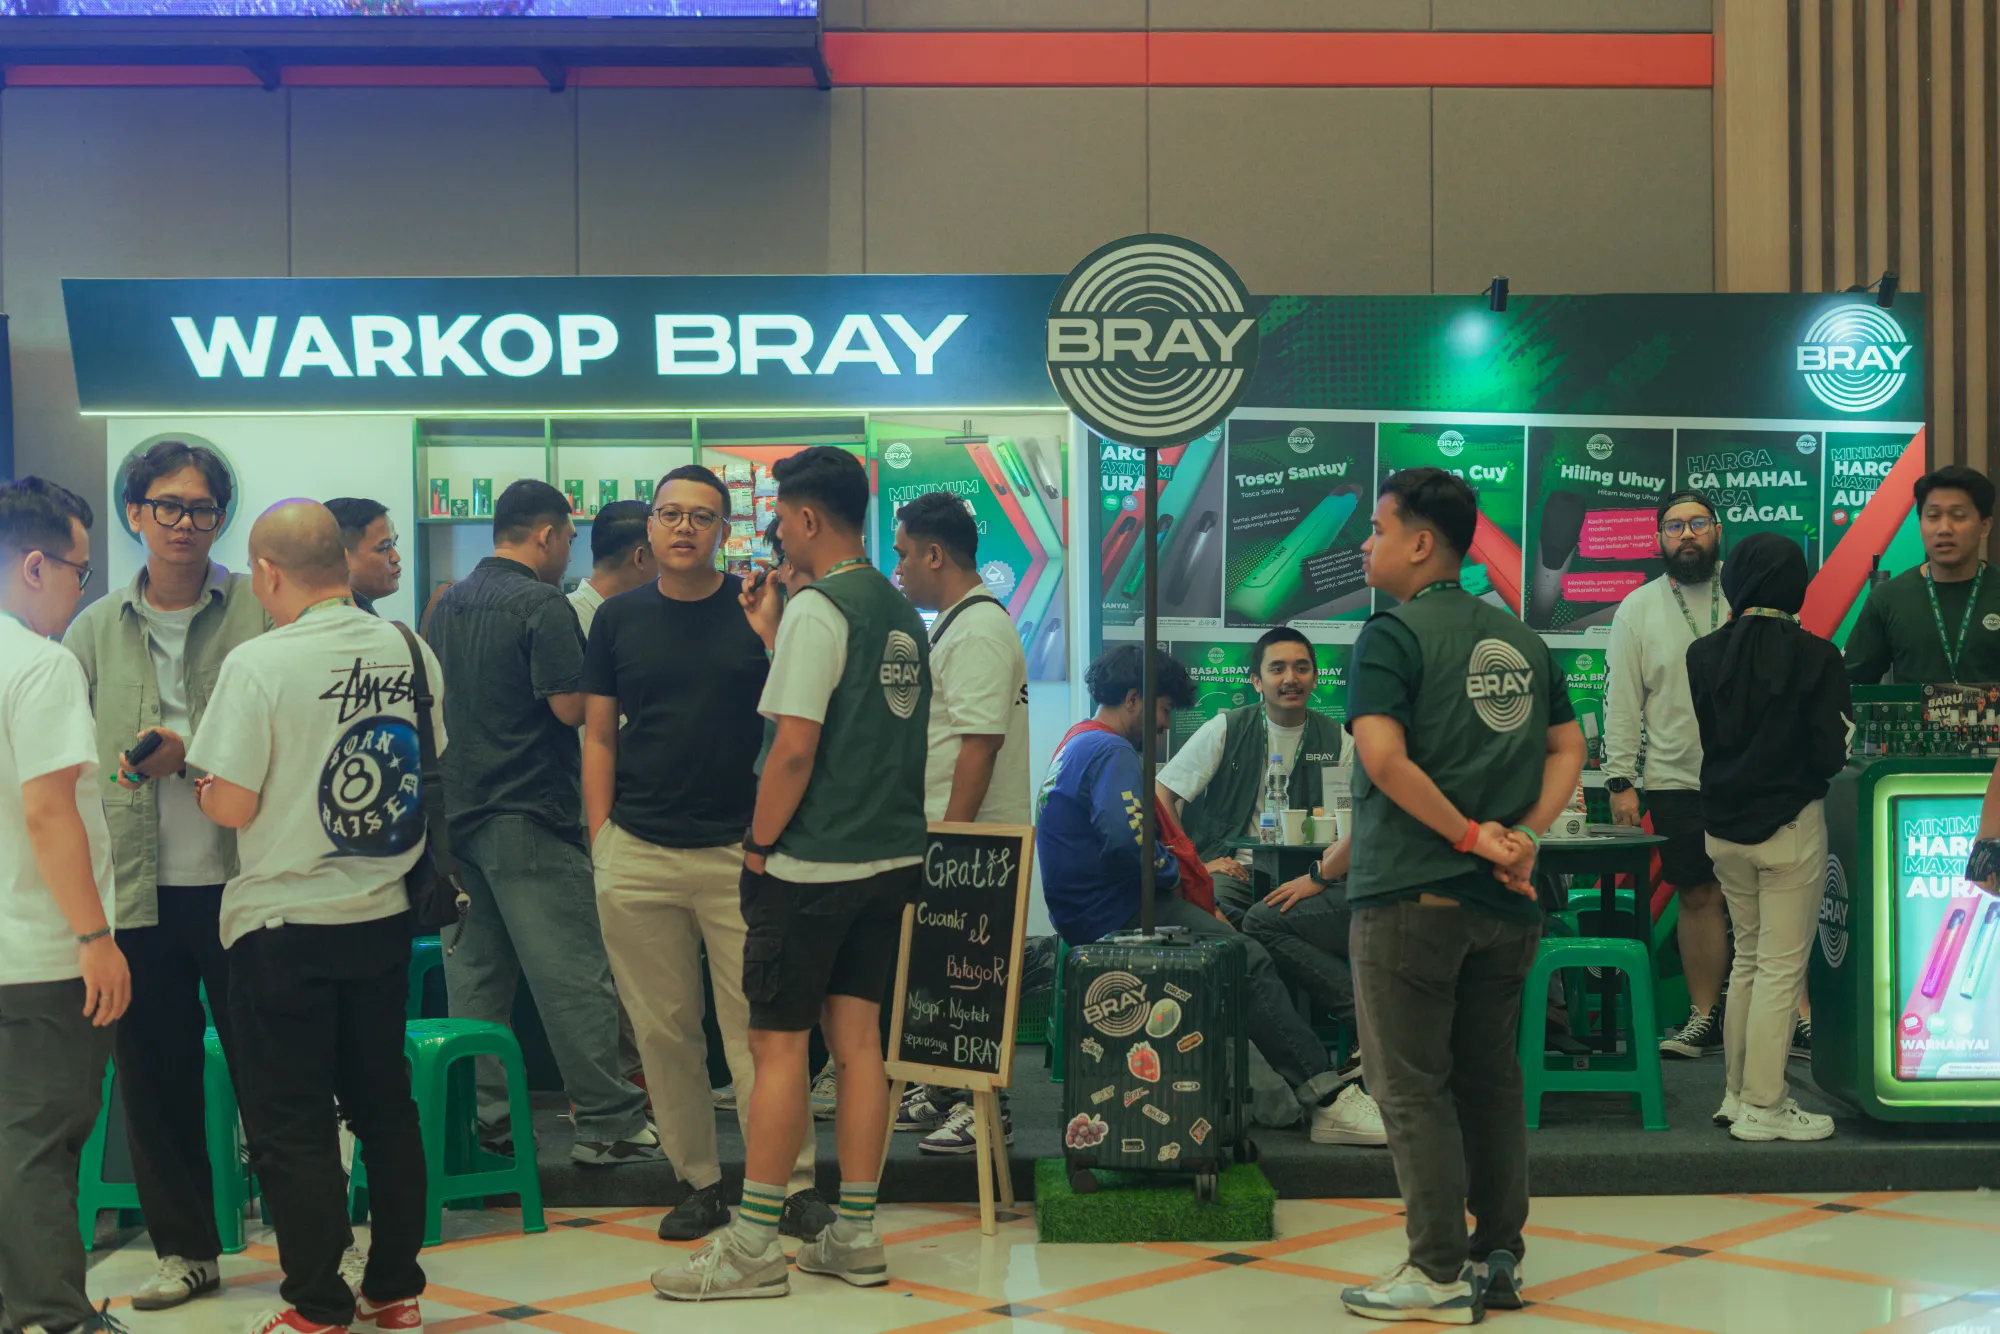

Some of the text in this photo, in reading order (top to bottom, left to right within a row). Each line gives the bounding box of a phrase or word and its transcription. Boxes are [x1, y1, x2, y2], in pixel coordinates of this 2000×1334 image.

[171, 314, 969, 378] WARKOP BRAY
[1047, 318, 1256, 362] BRAY
[1796, 345, 1913, 371] BRAY
[1287, 436, 1316, 444] BRAY
[1437, 439, 1466, 447] BRAY
[884, 452, 913, 460] BRAY
[1100, 445, 1162, 462] ARG
[1687, 449, 1773, 474] HARGA
[1100, 461, 1171, 479] AXIMM
[1235, 462, 1348, 488] Toscy Santuy
[1469, 465, 1509, 483] Cuy
[1561, 464, 1666, 492] Hiling Uhuy
[1100, 474, 1146, 492] URA
[1687, 470, 1808, 489] GA MAHAL
[1240, 487, 1285, 499] Tosca Santuy
[1597, 489, 1660, 502] Hitam Keling Uhuy
[1726, 505, 1804, 523] GAGAL
[880, 663, 921, 685] BRAY
[1190, 666, 1250, 675] RASA BRAY
[1564, 674, 1588, 682] ASA
[1225, 676, 1235, 684] LU
[1466, 669, 1534, 699] BRAY
[1927, 693, 1963, 708] BARU
[328, 730, 394, 770] BORN
[1305, 753, 1335, 761] BRAY
[339, 757, 374, 804] 8
[322, 772, 419, 838] RAISED
[1819, 897, 1849, 927] BRAY
[1165, 984, 1191, 1001] BRAY
[1083, 984, 1148, 1024] BRAY
[954, 1034, 1002, 1069] BRAY
